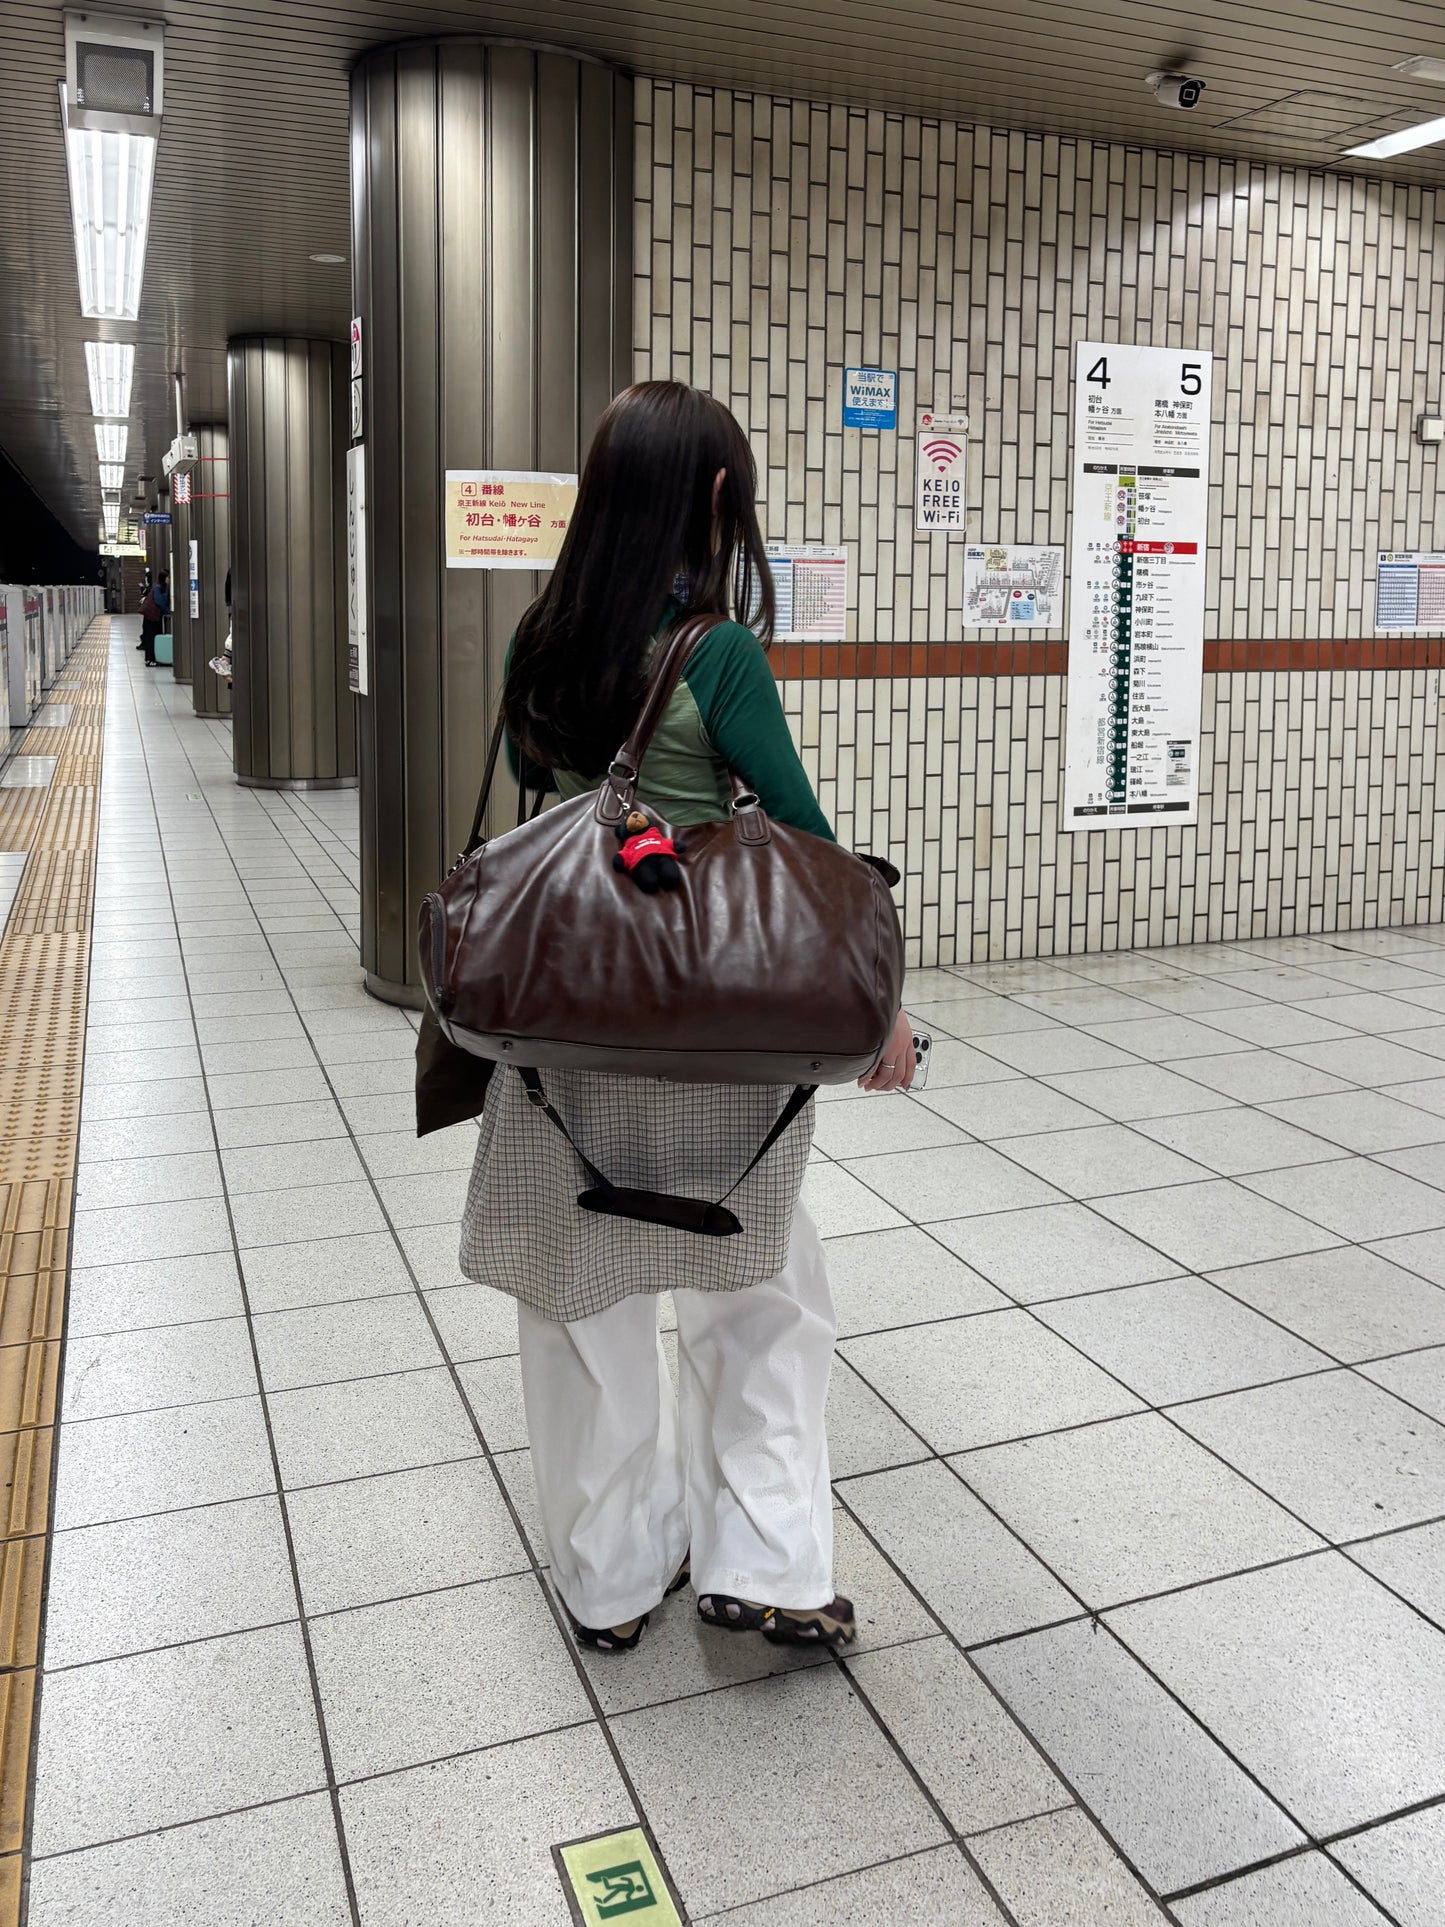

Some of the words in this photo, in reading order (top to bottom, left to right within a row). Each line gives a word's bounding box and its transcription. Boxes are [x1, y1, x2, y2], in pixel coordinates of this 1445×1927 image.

[1086, 357, 1111, 389] 4
[857, 372, 884, 383] 当駅で
[1180, 363, 1202, 395] 5
[850, 385, 891, 398] WiMAX
[1088, 395, 1102, 404] 初台
[1172, 401, 1193, 410] 神保町
[1154, 410, 1175, 418] 本八幡
[923, 479, 960, 492] KEIO
[465, 485, 472, 494] 4
[482, 484, 504, 496] 番線
[489, 500, 506, 508] Keiō
[530, 501, 546, 509] Line
[923, 495, 960, 508] FREE
[923, 510, 960, 523] Wi-Fi
[550, 520, 566, 528] 方面
[1138, 517, 1150, 525] 初台
[1137, 543, 1150, 551] 新宿
[1136, 556, 1166, 564] 新宿三丁目
[1135, 594, 1154, 602] 九段下
[1135, 606, 1154, 614] 神保町
[1133, 655, 1146, 663] 浜町
[1133, 668, 1146, 676] 森下
[1133, 680, 1145, 688] 菊川
[1132, 692, 1145, 700] 住吉
[1130, 753, 1149, 761] 一之江
[1129, 790, 1147, 798] 本八幡
